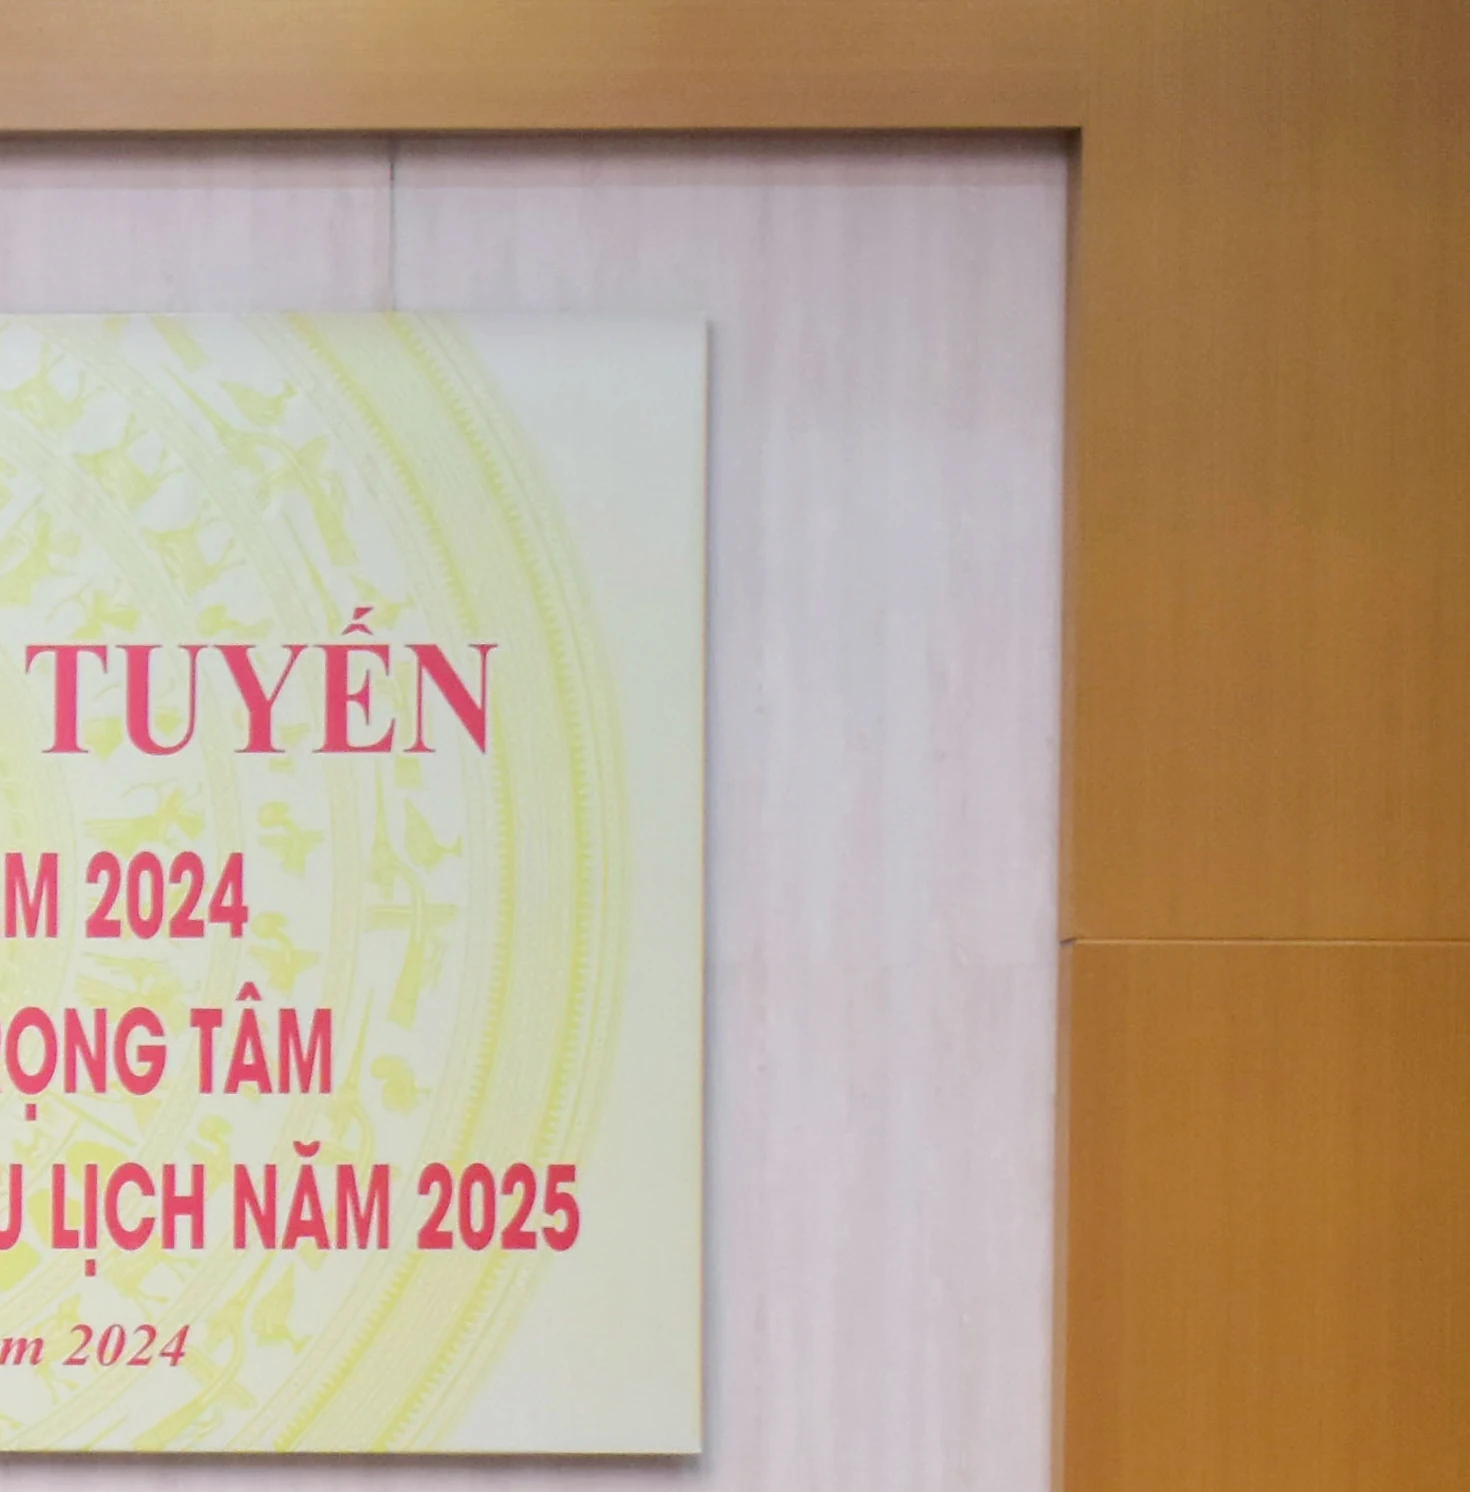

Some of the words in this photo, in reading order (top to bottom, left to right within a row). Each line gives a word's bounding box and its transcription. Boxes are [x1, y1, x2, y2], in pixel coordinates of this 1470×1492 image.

[24, 607, 498, 756] TUYẾN
[86, 851, 249, 940] 2024
[191, 981, 332, 1094] TÂM
[52, 1162, 206, 1277] LỊCH
[234, 1141, 391, 1250] NĂM
[418, 1162, 581, 1252] 2025
[65, 1324, 189, 1367] 2024
